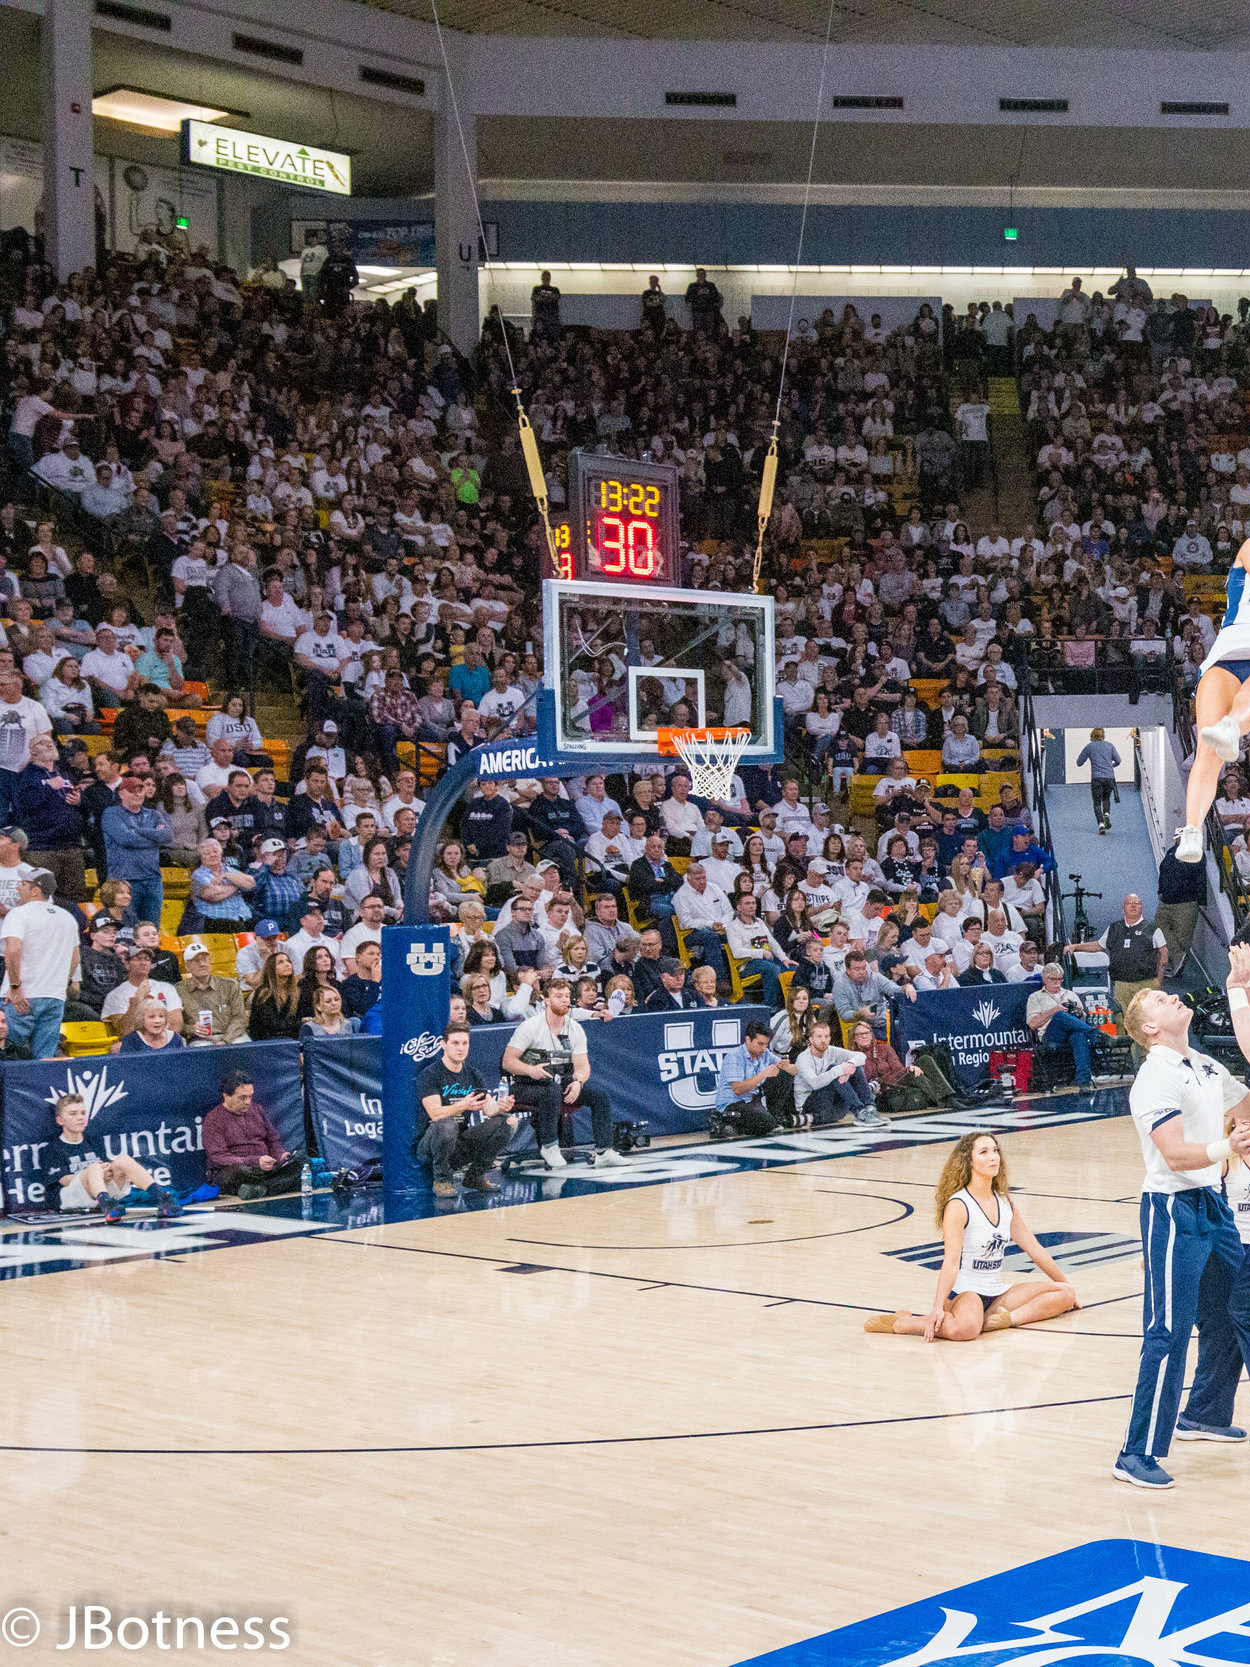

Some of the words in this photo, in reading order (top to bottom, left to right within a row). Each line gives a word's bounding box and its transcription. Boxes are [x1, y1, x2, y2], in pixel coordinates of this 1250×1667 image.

[216, 137, 325, 177] ELEVATE
[69, 166, 84, 188] T
[218, 158, 252, 171] PEST
[260, 167, 322, 186] CONTROL
[459, 243, 471, 262] U
[601, 480, 660, 518] 13:22
[602, 516, 654, 576] 30
[226, 723, 252, 733] USU
[806, 893, 830, 904] STRIPE
[407, 953, 445, 966] STATE
[410, 943, 444, 976] U
[658, 1048, 736, 1082] STAT
[959, 1051, 989, 1067] Regio
[519, 1108, 1116, 1184] STATE
[973, 1260, 991, 1270] UTAH
